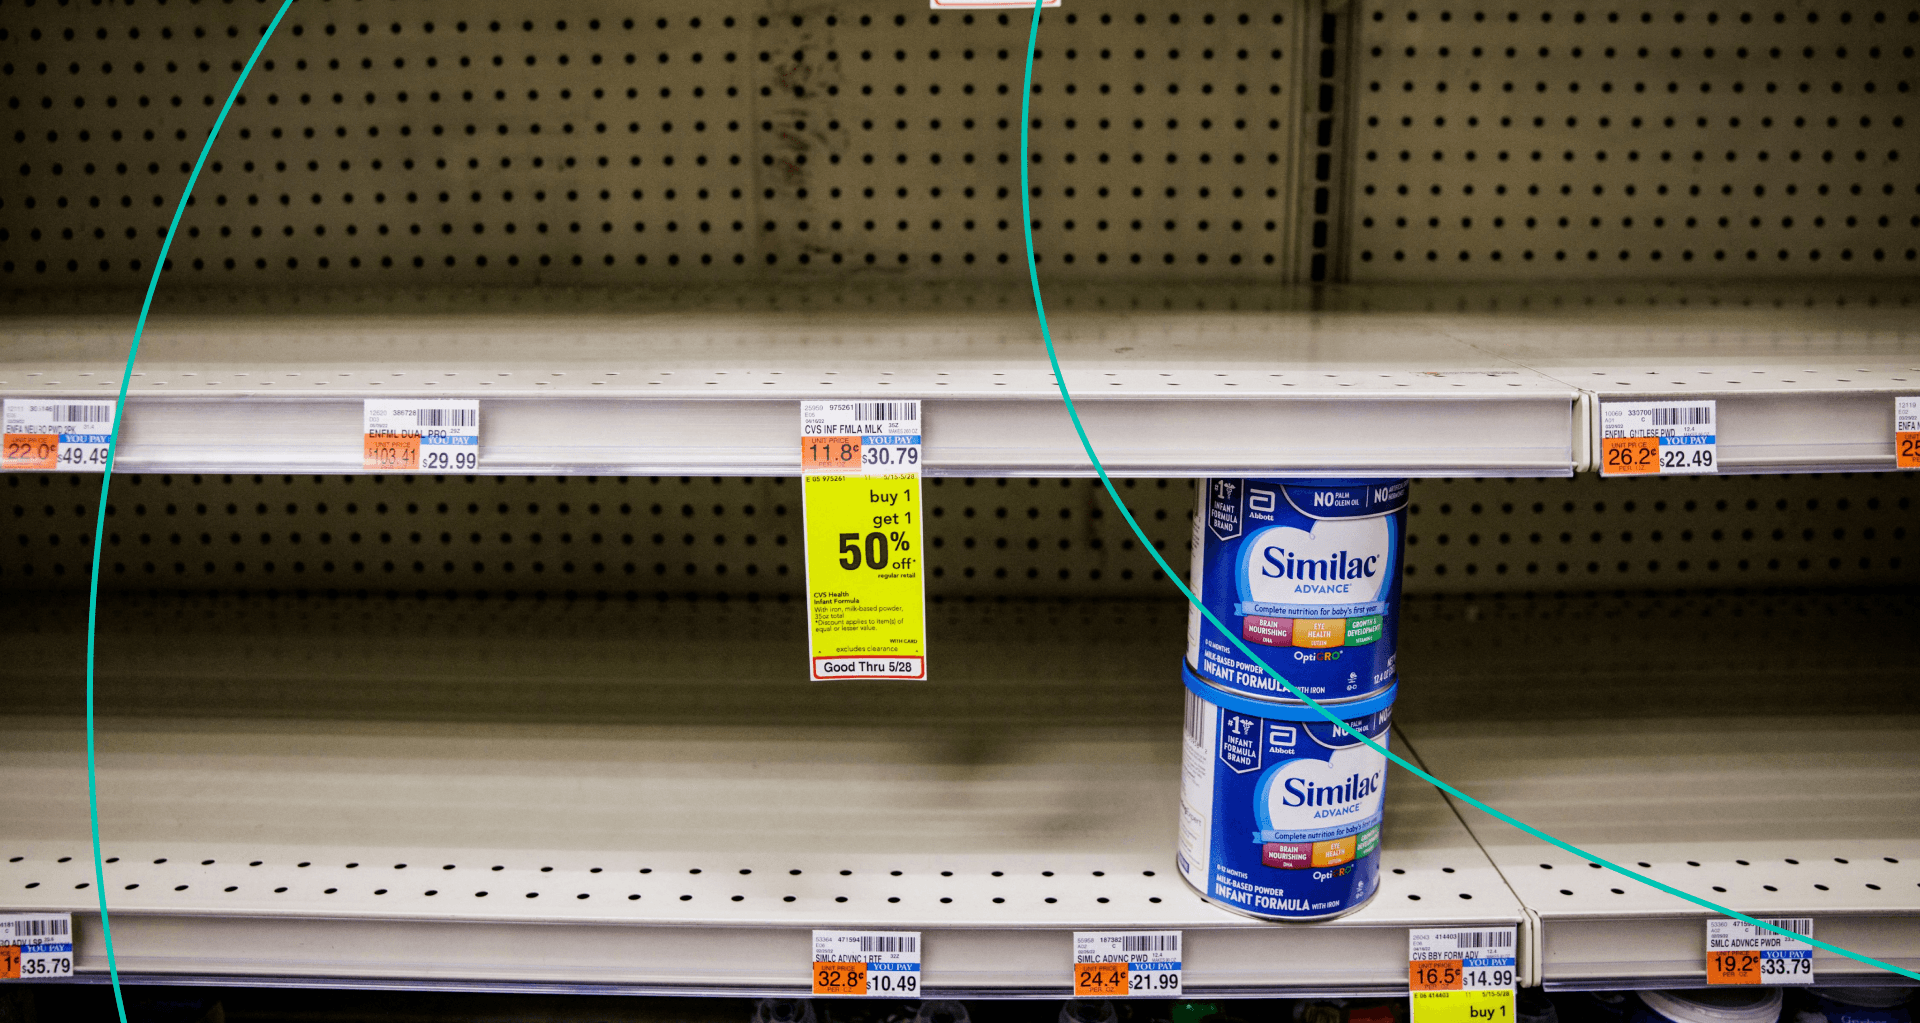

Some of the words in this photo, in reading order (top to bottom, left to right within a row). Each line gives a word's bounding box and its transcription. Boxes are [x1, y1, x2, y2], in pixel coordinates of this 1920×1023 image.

[402, 429, 425, 438] DUAL
[428, 429, 447, 438] PRO
[805, 425, 822, 434] CVS
[824, 424, 837, 434] INF
[840, 424, 862, 434] FMLA
[865, 424, 882, 433] MLK
[1661, 429, 1676, 437] PWD
[1899, 422, 1916, 430] ENFA
[65, 435, 87, 443] YOU
[89, 435, 107, 443] PAY
[868, 436, 892, 444] YOU
[894, 436, 913, 444] PAY
[1666, 437, 1689, 445] YOU
[58, 447, 108, 465] $49.49
[810, 444, 859, 461] 11.8¢
[862, 448, 918, 465] $30.79
[1608, 448, 1656, 466] 26.2¢
[1660, 450, 1713, 468] $22.49
[422, 452, 476, 469] $29.99
[1215, 480, 1224, 499] #1
[1374, 487, 1388, 504] NO
[870, 489, 898, 506] buy
[904, 489, 910, 502] 1
[1314, 492, 1334, 507] NO
[1214, 500, 1235, 514] INFANT
[873, 513, 898, 528] get
[904, 512, 911, 524] 1
[1211, 511, 1238, 524] FORMULA
[1249, 512, 1274, 521] Abbott
[1214, 518, 1233, 532] BRAND
[839, 531, 910, 570] 50%
[1262, 546, 1377, 581] Similac
[1294, 584, 1349, 594] ADVANCE
[879, 605, 903, 613] powder,
[1254, 604, 1286, 615] Complete
[1288, 607, 1319, 616] nutrition
[1332, 607, 1352, 616] baby's
[1354, 606, 1365, 614] first
[1366, 605, 1377, 615] year
[1259, 619, 1278, 628] BRAIN
[1248, 626, 1287, 637] NOURISHING
[1308, 630, 1331, 638] HEALTH
[1204, 650, 1235, 668] MILK-BASED
[1236, 661, 1264, 674] POWDER
[1294, 651, 1341, 664] OptiGRO
[824, 662, 855, 673] Good
[858, 662, 885, 672] Thru
[889, 662, 912, 672] 5/28
[1204, 659, 1234, 682] INFANT
[1228, 716, 1240, 734] #1
[1228, 736, 1253, 749] INFANT
[1224, 743, 1256, 759] FORMULA
[1269, 746, 1295, 755] Abbott
[1227, 752, 1251, 765] BRAND
[1282, 772, 1379, 807] Similac
[1313, 804, 1360, 819] ADVANCE
[1275, 832, 1306, 841] Complete
[1308, 831, 1335, 839] nutrition
[1336, 828, 1344, 836] for
[1346, 824, 1361, 834] baby's
[1268, 852, 1307, 860] NOURISHING
[1217, 864, 1226, 872] 0-12
[1227, 868, 1248, 880] MONTHS
[1313, 866, 1351, 882] OptiGRO
[1216, 874, 1253, 892] MILK-BASED
[1254, 887, 1284, 897] POWDER
[1215, 883, 1252, 905] INFANT
[1255, 895, 1310, 911] FORMULA
[1312, 902, 1326, 910] WITH
[1327, 900, 1340, 908] IRON
[1711, 939, 1730, 948] SMLC
[1731, 939, 1759, 947] ADVNCE
[1761, 938, 1780, 947] PWDR
[816, 954, 836, 962] SIMLC
[869, 955, 882, 963] RTF
[1077, 955, 1100, 963] SIMLC
[1103, 955, 1129, 963] ADVNC
[1413, 952, 1426, 960] CVS
[1429, 952, 1442, 960] BBY
[1444, 952, 1463, 960] FORM
[1465, 951, 1479, 959] ADV
[22, 958, 70, 974] $35.79
[1715, 956, 1758, 972] 19.2¢
[1761, 959, 1810, 974] $33.79
[818, 971, 864, 987] 32.8¢
[866, 975, 916, 991] $10.49
[1080, 972, 1126, 987] 24.4¢
[1128, 974, 1178, 990] $21.99
[1416, 968, 1461, 984] 16.5¢
[1463, 970, 1512, 986] $14.99
[1470, 1005, 1495, 1021] buy
[1500, 1005, 1505, 1017] 1
